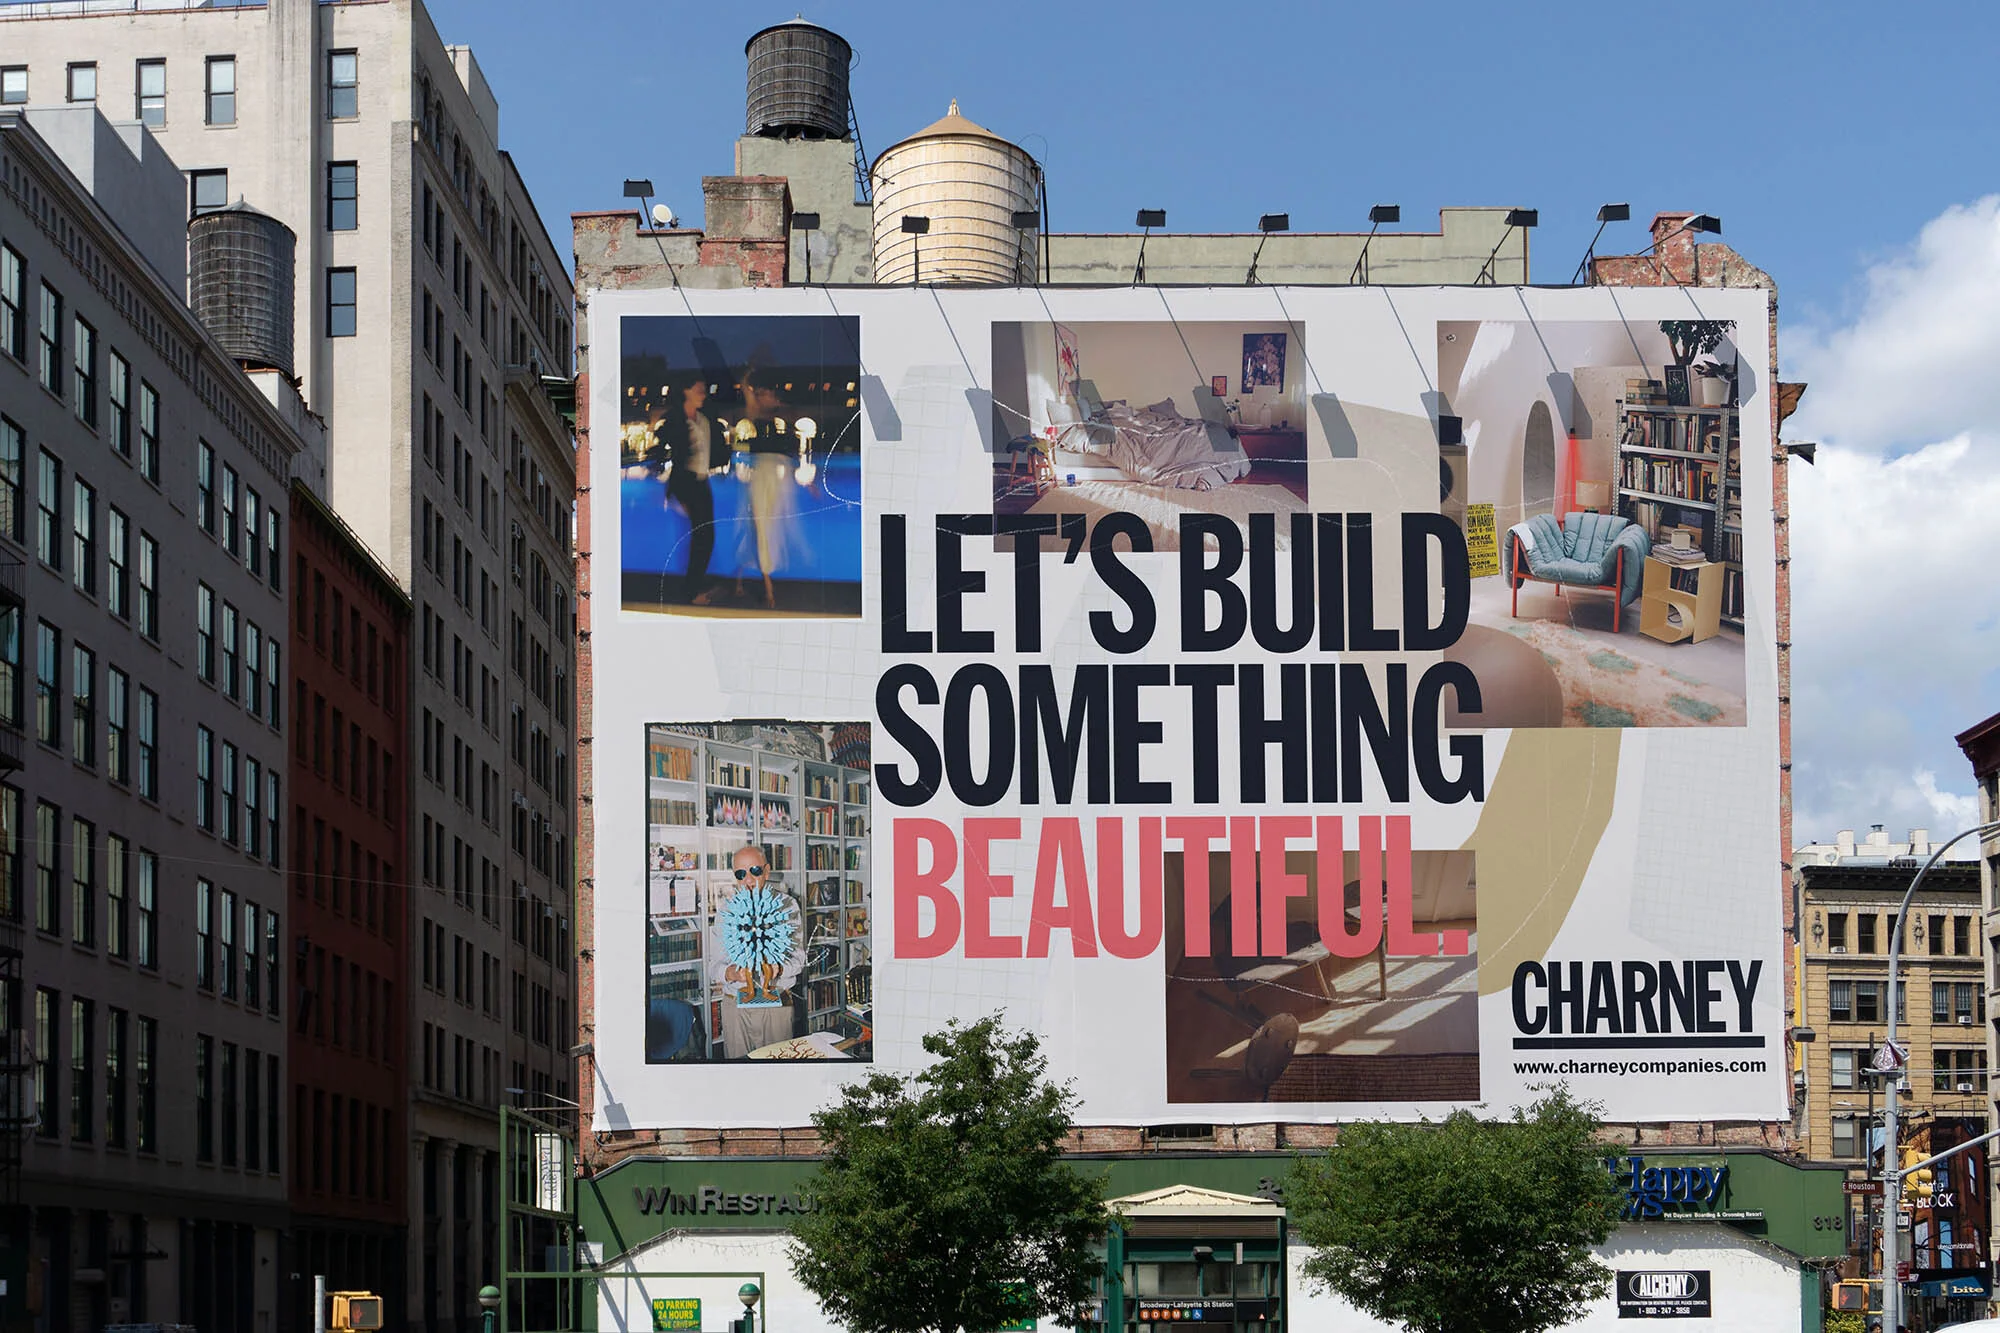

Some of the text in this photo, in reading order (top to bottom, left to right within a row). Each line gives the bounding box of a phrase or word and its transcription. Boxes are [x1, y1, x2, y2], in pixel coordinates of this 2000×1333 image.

[880, 511, 1471, 654] LET'S BUILD
[874, 661, 1485, 807] SOMETHING
[893, 815, 1469, 960] BEAUTIFUL.
[1512, 960, 1763, 1035] CHARNEY
[1514, 1058, 1767, 1076] www.charneycompanies.com
[1604, 1156, 1727, 1203] Happy
[1842, 1182, 1876, 1190] E Houston
[1916, 1193, 1954, 1208] BLOCK
[1952, 1286, 1984, 1294] bite
[653, 1300, 698, 1310] NO PARKING
[1140, 1301, 1202, 1309] Broadway-Lafayette
[658, 1310, 694, 1320] 24 HOURS
